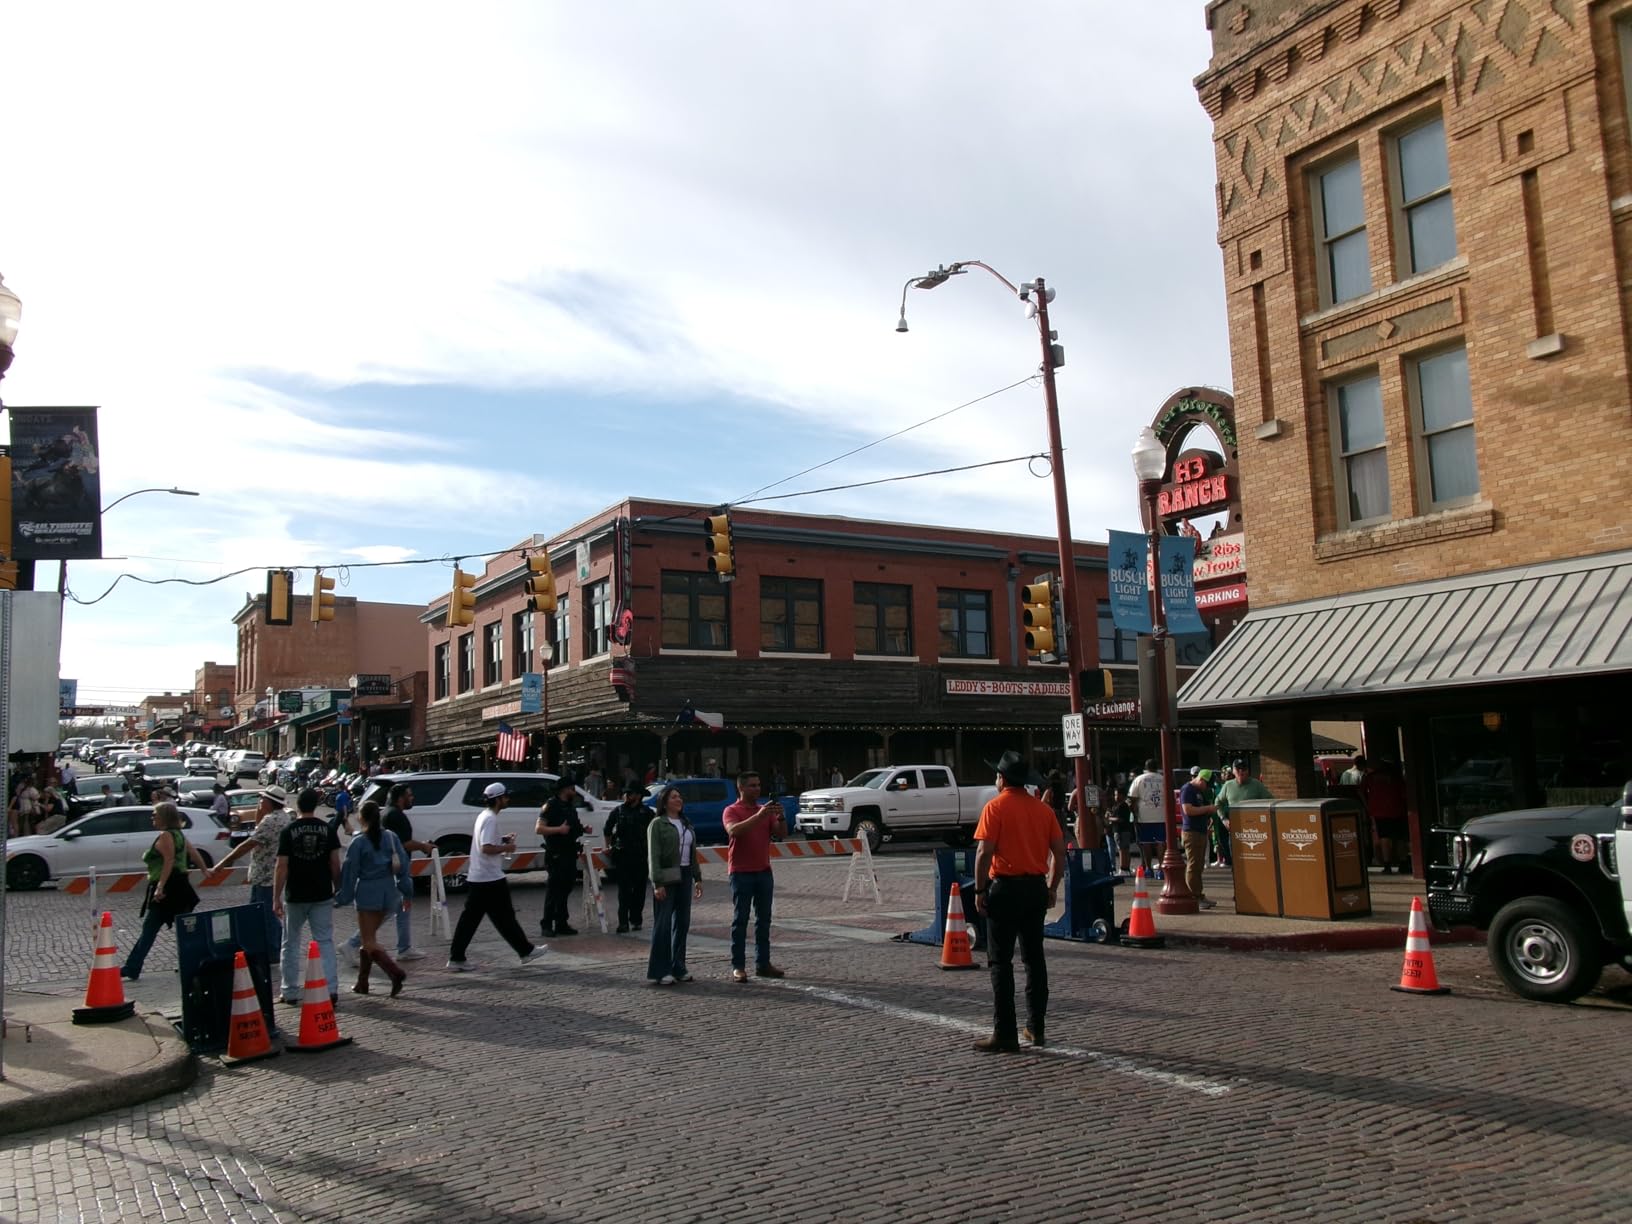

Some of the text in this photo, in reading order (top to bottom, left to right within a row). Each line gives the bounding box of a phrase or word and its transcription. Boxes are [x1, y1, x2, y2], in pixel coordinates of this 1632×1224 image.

[1174, 456, 1206, 484] H3
[1158, 474, 1228, 516] RANCH
[1213, 543, 1241, 557] Ribs
[1206, 557, 1241, 574] Trout
[1110, 568, 1147, 586] BUSCH
[1160, 574, 1193, 588] BUSCH
[1115, 584, 1142, 595] LIGHT
[1165, 588, 1188, 598] LIGHT
[1195, 589, 1240, 605] PARKING
[1095, 703, 1101, 715] E
[1102, 701, 1135, 715] Exchange
[1065, 718, 1080, 729] ONE
[1066, 729, 1080, 740] WAY
[290, 824, 328, 840] MAGELLAN
[1235, 832, 1268, 840] STOCKYARDS
[1281, 832, 1318, 840] STOCKYARDS
